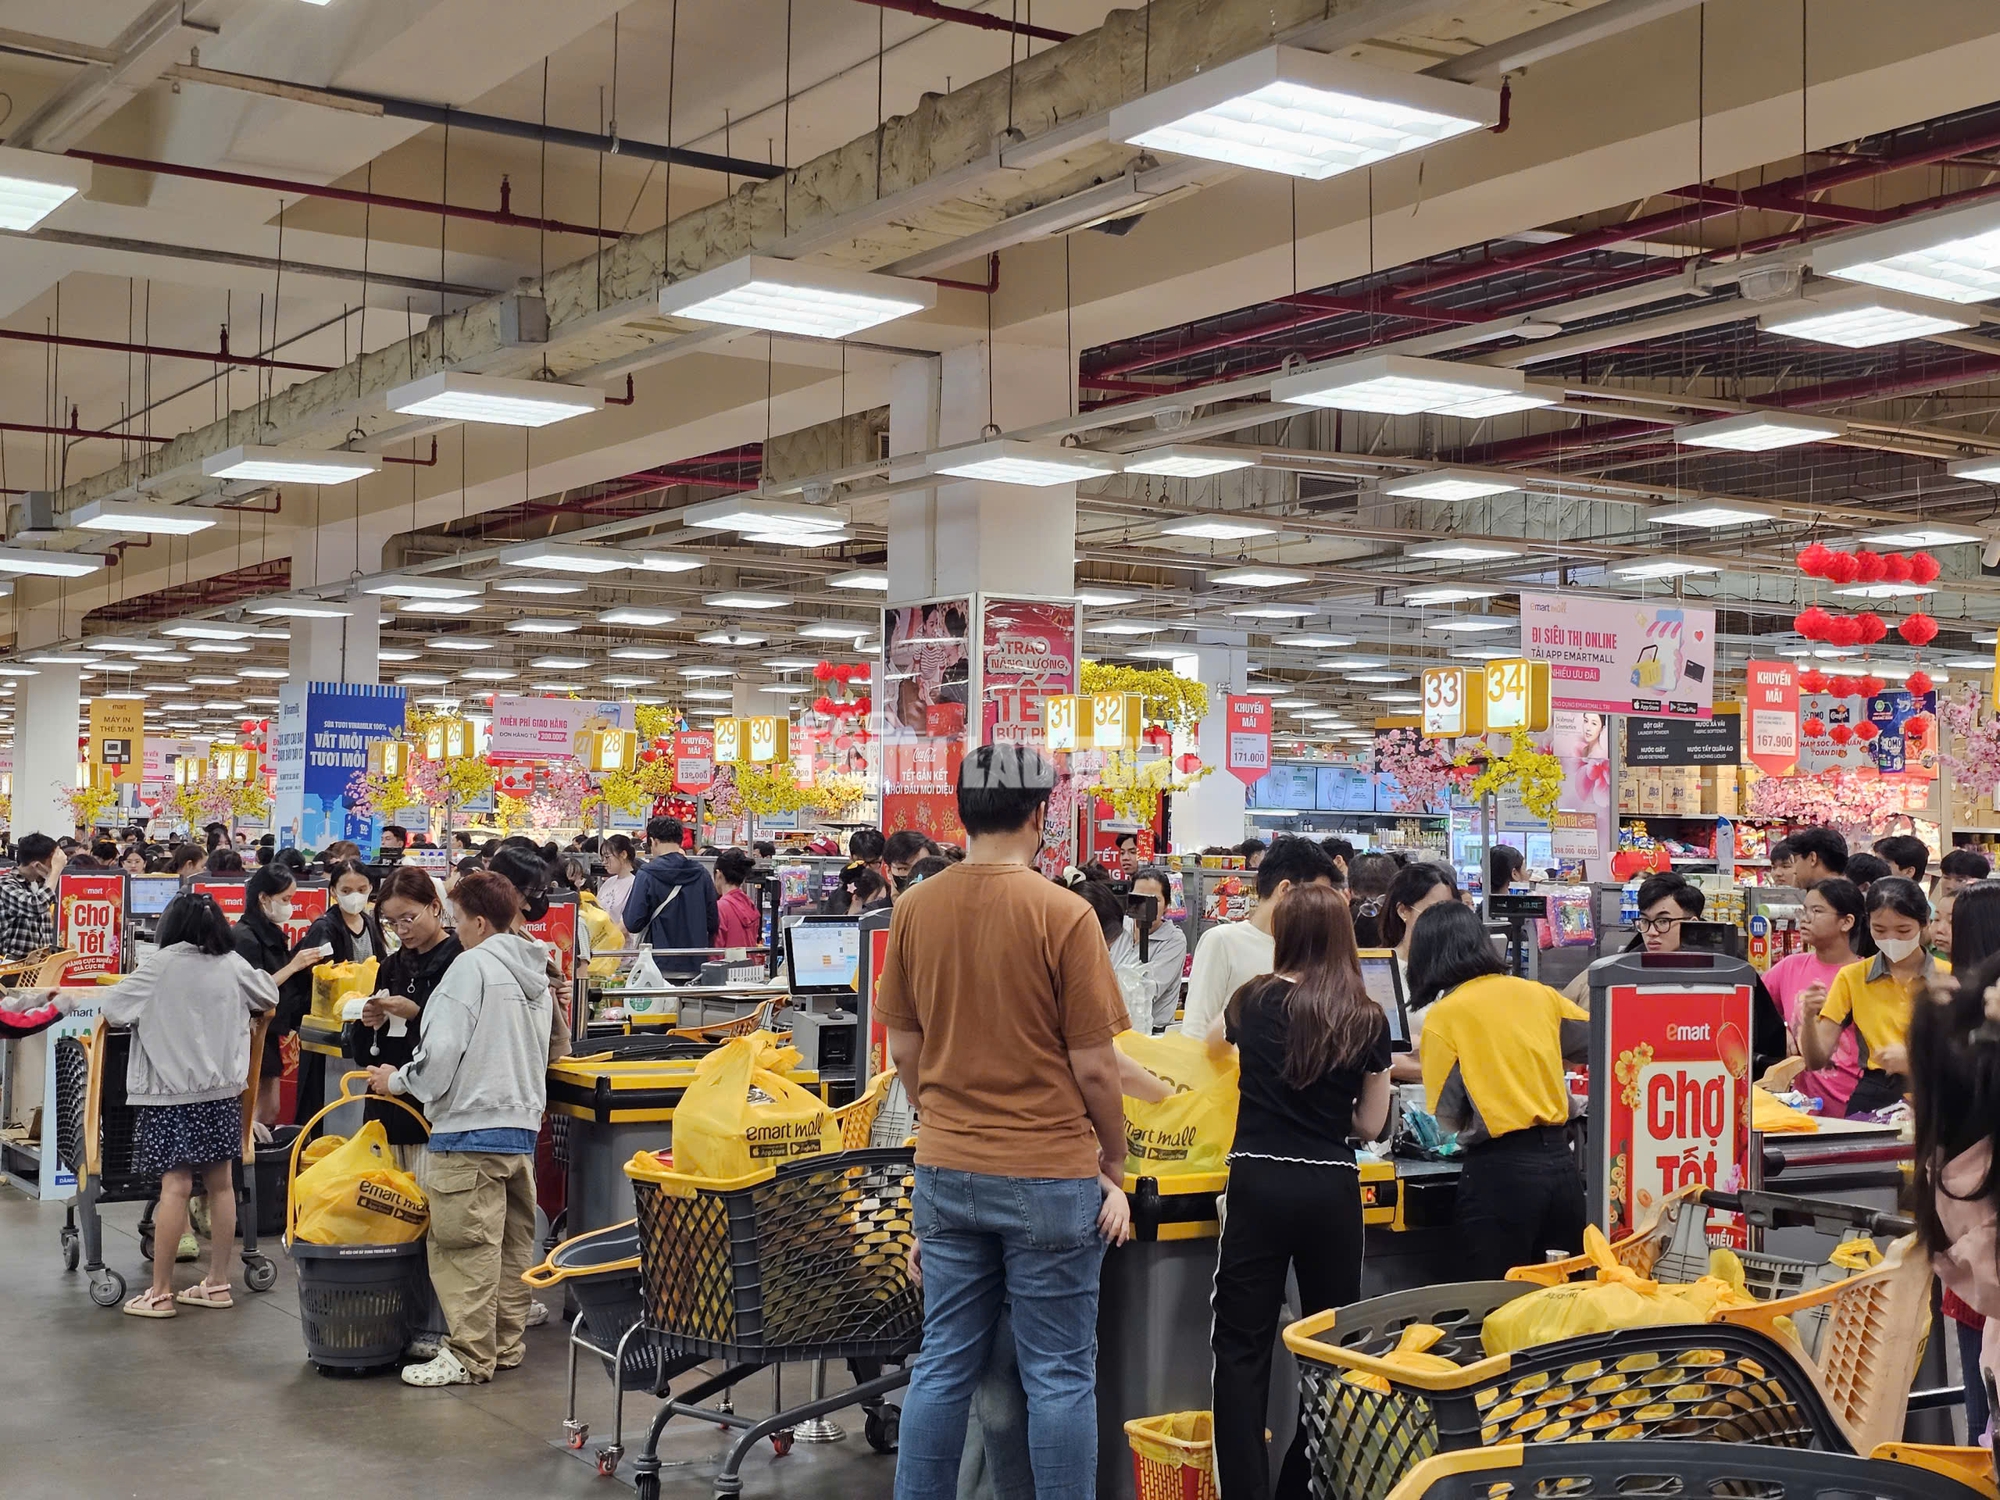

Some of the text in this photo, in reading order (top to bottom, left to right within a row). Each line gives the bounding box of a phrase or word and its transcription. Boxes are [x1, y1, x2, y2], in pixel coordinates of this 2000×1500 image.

[1531, 625, 1617, 650] ĐI SIÊU THỊ ONLINE
[1005, 640, 1047, 655] TRAO
[1531, 646, 1615, 664] TẢI APP EMARTMALL
[991, 657, 1068, 672] NĂNG LƯỢNG,
[1573, 669, 1583, 680] ƯU
[1584, 670, 1597, 680] ĐÃI
[1757, 669, 1791, 686] KHUYẾN
[1427, 674, 1458, 707] 33
[1489, 665, 1524, 703] 34
[1766, 687, 1783, 703] MÃI
[1051, 698, 1071, 728] 31
[1095, 698, 1121, 726] 32
[1234, 701, 1264, 714] KHUYẾN
[103, 715, 121, 723] MÁY
[519, 717, 530, 727] PHÍ
[532, 718, 548, 729] GIAO
[549, 717, 567, 729] HÀNG
[1241, 716, 1257, 728] MÃI
[118, 726, 135, 734] TẠM
[428, 727, 440, 745] 25
[448, 725, 461, 743] 26
[717, 722, 736, 745] 29
[752, 721, 772, 744] 30
[575, 736, 590, 754] 27
[604, 734, 621, 753] 28
[1757, 734, 1793, 748] 167.900
[220, 753, 229, 768] 21
[1234, 752, 1265, 763] 171.000
[902, 766, 948, 781] TẾT GẮN KẾT
[887, 782, 954, 796] HỞI ĐẦU MỚI DIỆU
[1094, 847, 1119, 862] TẾT
[74, 903, 110, 930] Chợ
[525, 921, 547, 932] mart
[78, 928, 106, 954] Tết
[70, 1008, 93, 1018] mart
[1667, 1023, 1711, 1041] emart
[1647, 1070, 1725, 1147] Chợ
[746, 1112, 825, 1141] emart mall
[1157, 1126, 1197, 1147] mall
[359, 1180, 403, 1205] emart
